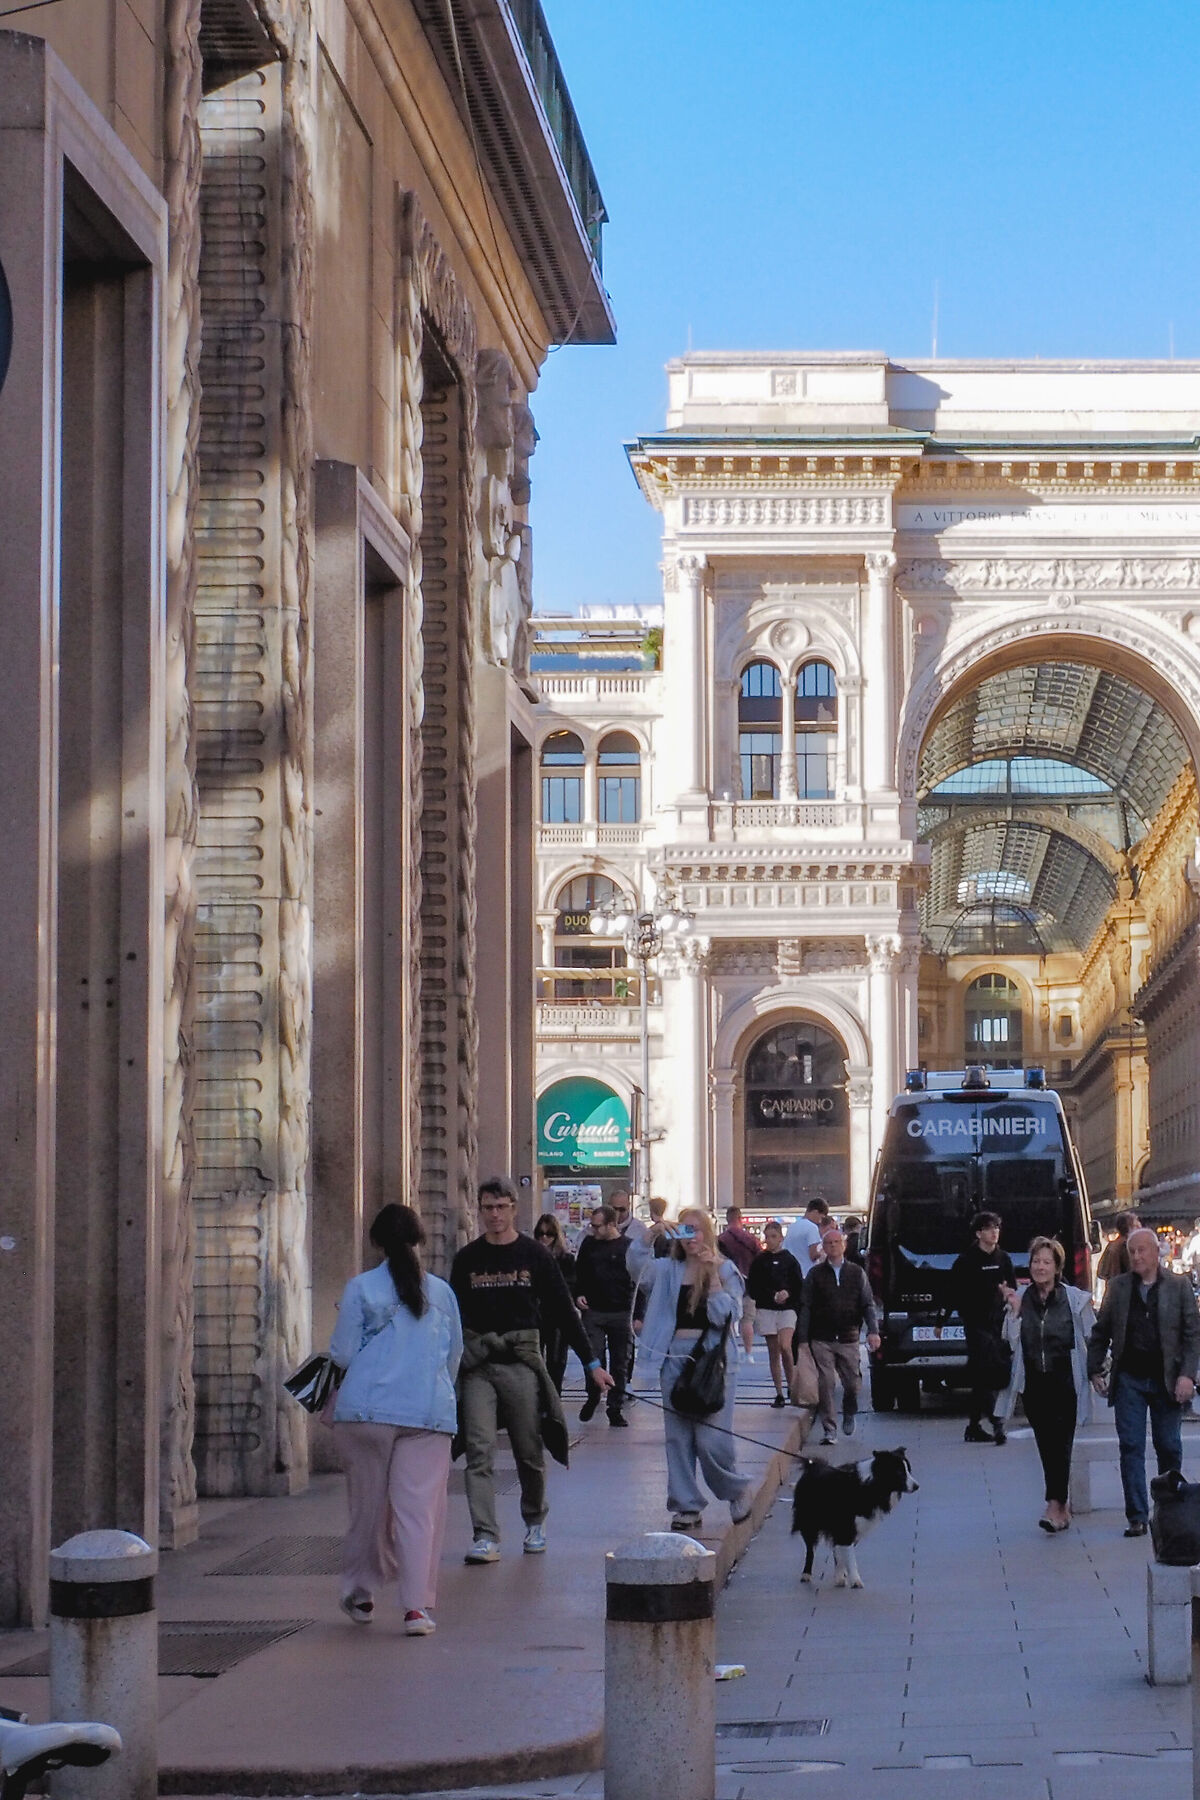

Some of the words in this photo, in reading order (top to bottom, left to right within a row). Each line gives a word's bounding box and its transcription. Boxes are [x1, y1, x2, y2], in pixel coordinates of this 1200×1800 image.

[565, 915, 593, 926] DUO
[760, 1098, 834, 1113] CAMPARINO
[907, 1117, 1046, 1138] CARABINIERI
